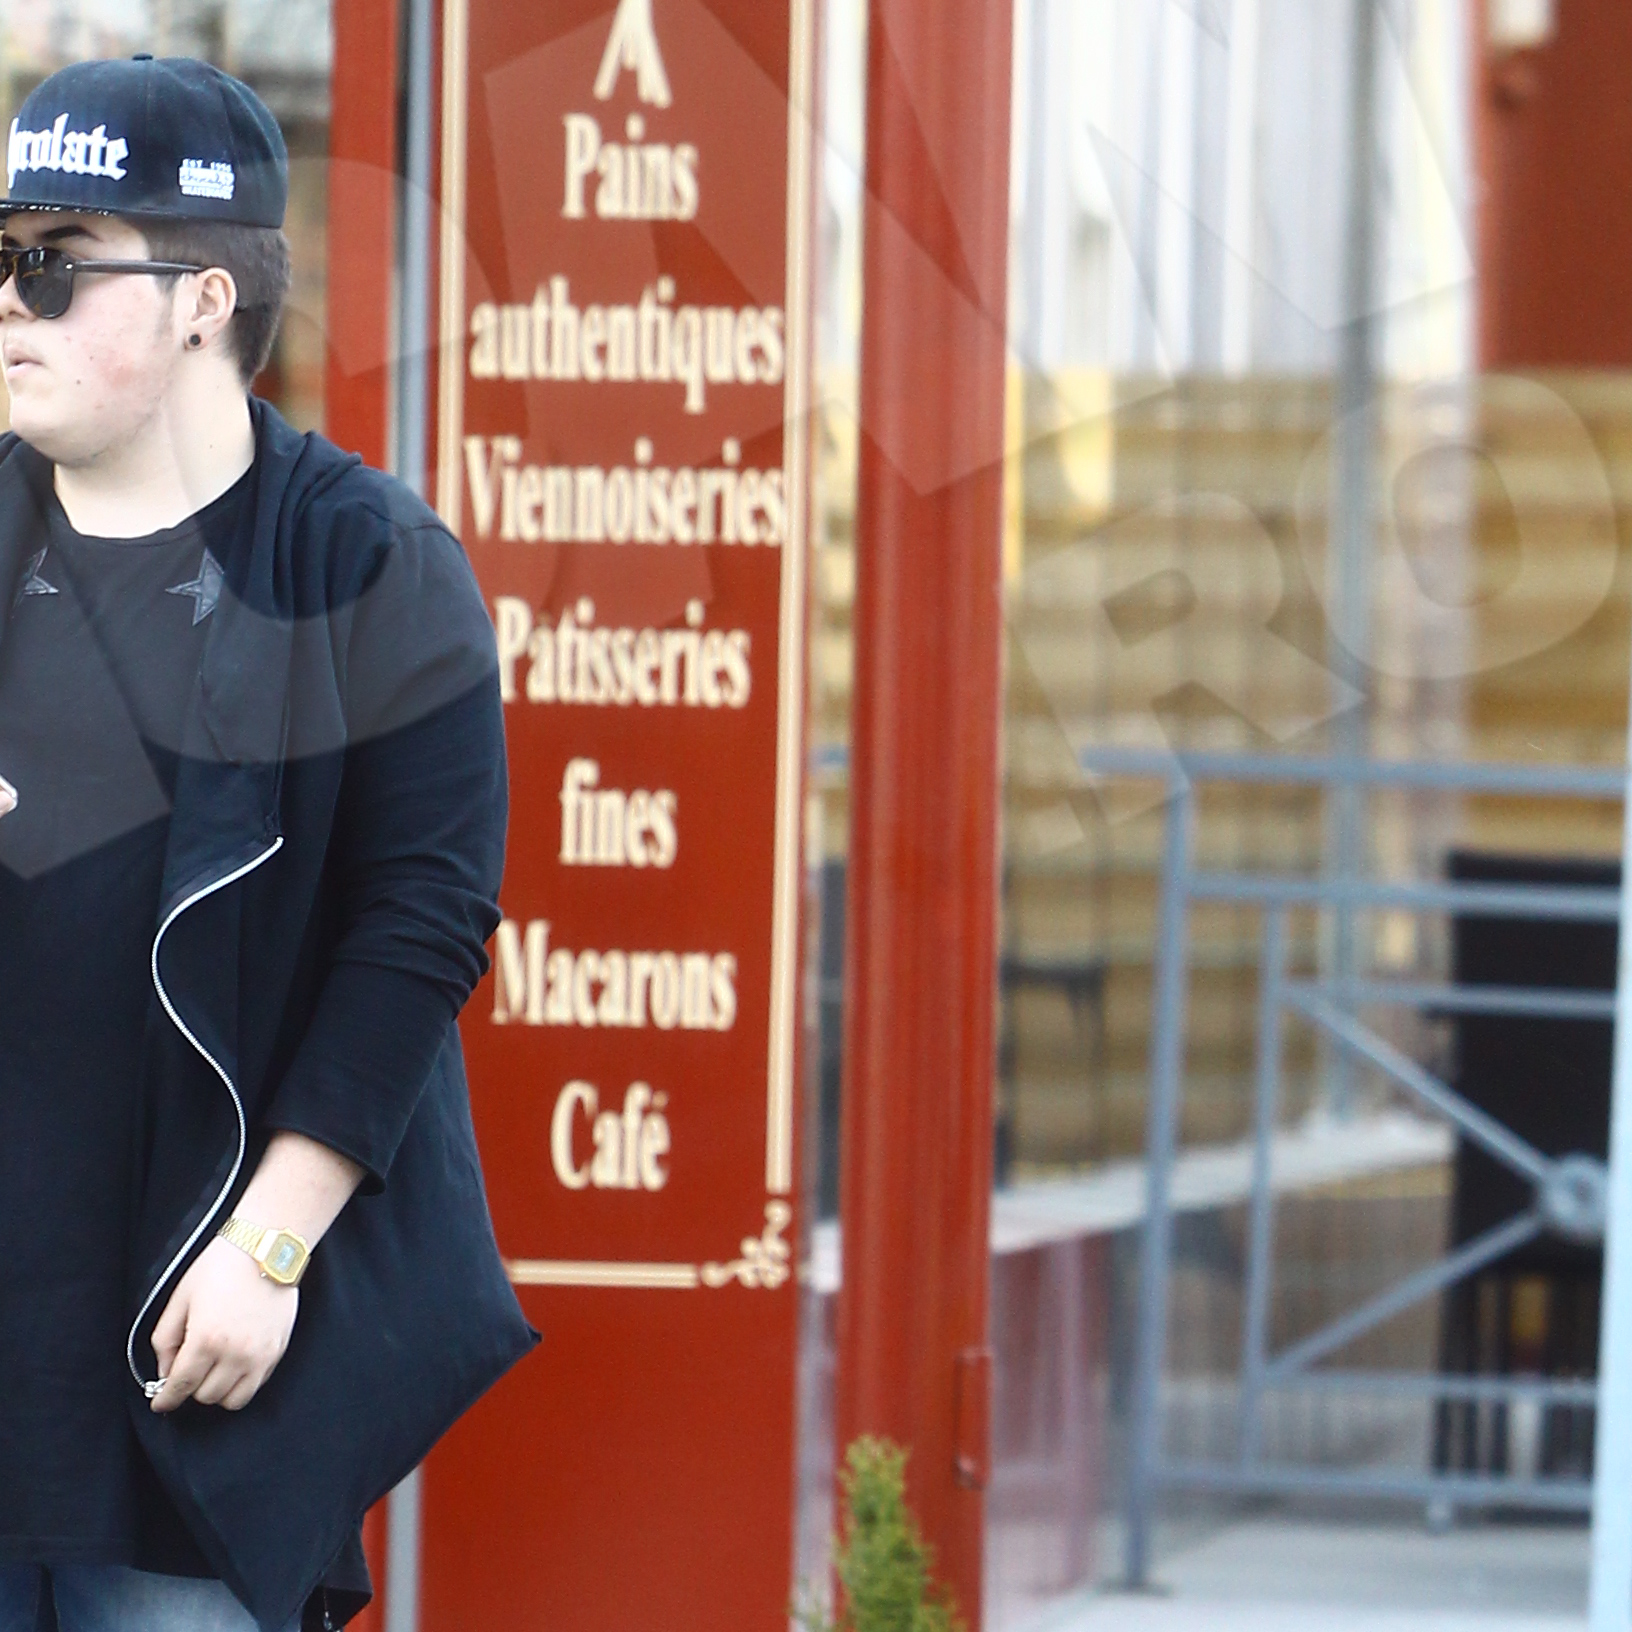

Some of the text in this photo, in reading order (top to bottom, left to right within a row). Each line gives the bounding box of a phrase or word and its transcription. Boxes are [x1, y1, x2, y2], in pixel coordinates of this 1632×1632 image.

[560, 112, 699, 222] Pains
[469, 274, 785, 415] authentiques
[464, 436, 787, 547] Viennoiseries
[558, 757, 678, 869] fines
[490, 918, 737, 1031] Macarons
[550, 1078, 672, 1191] Café
